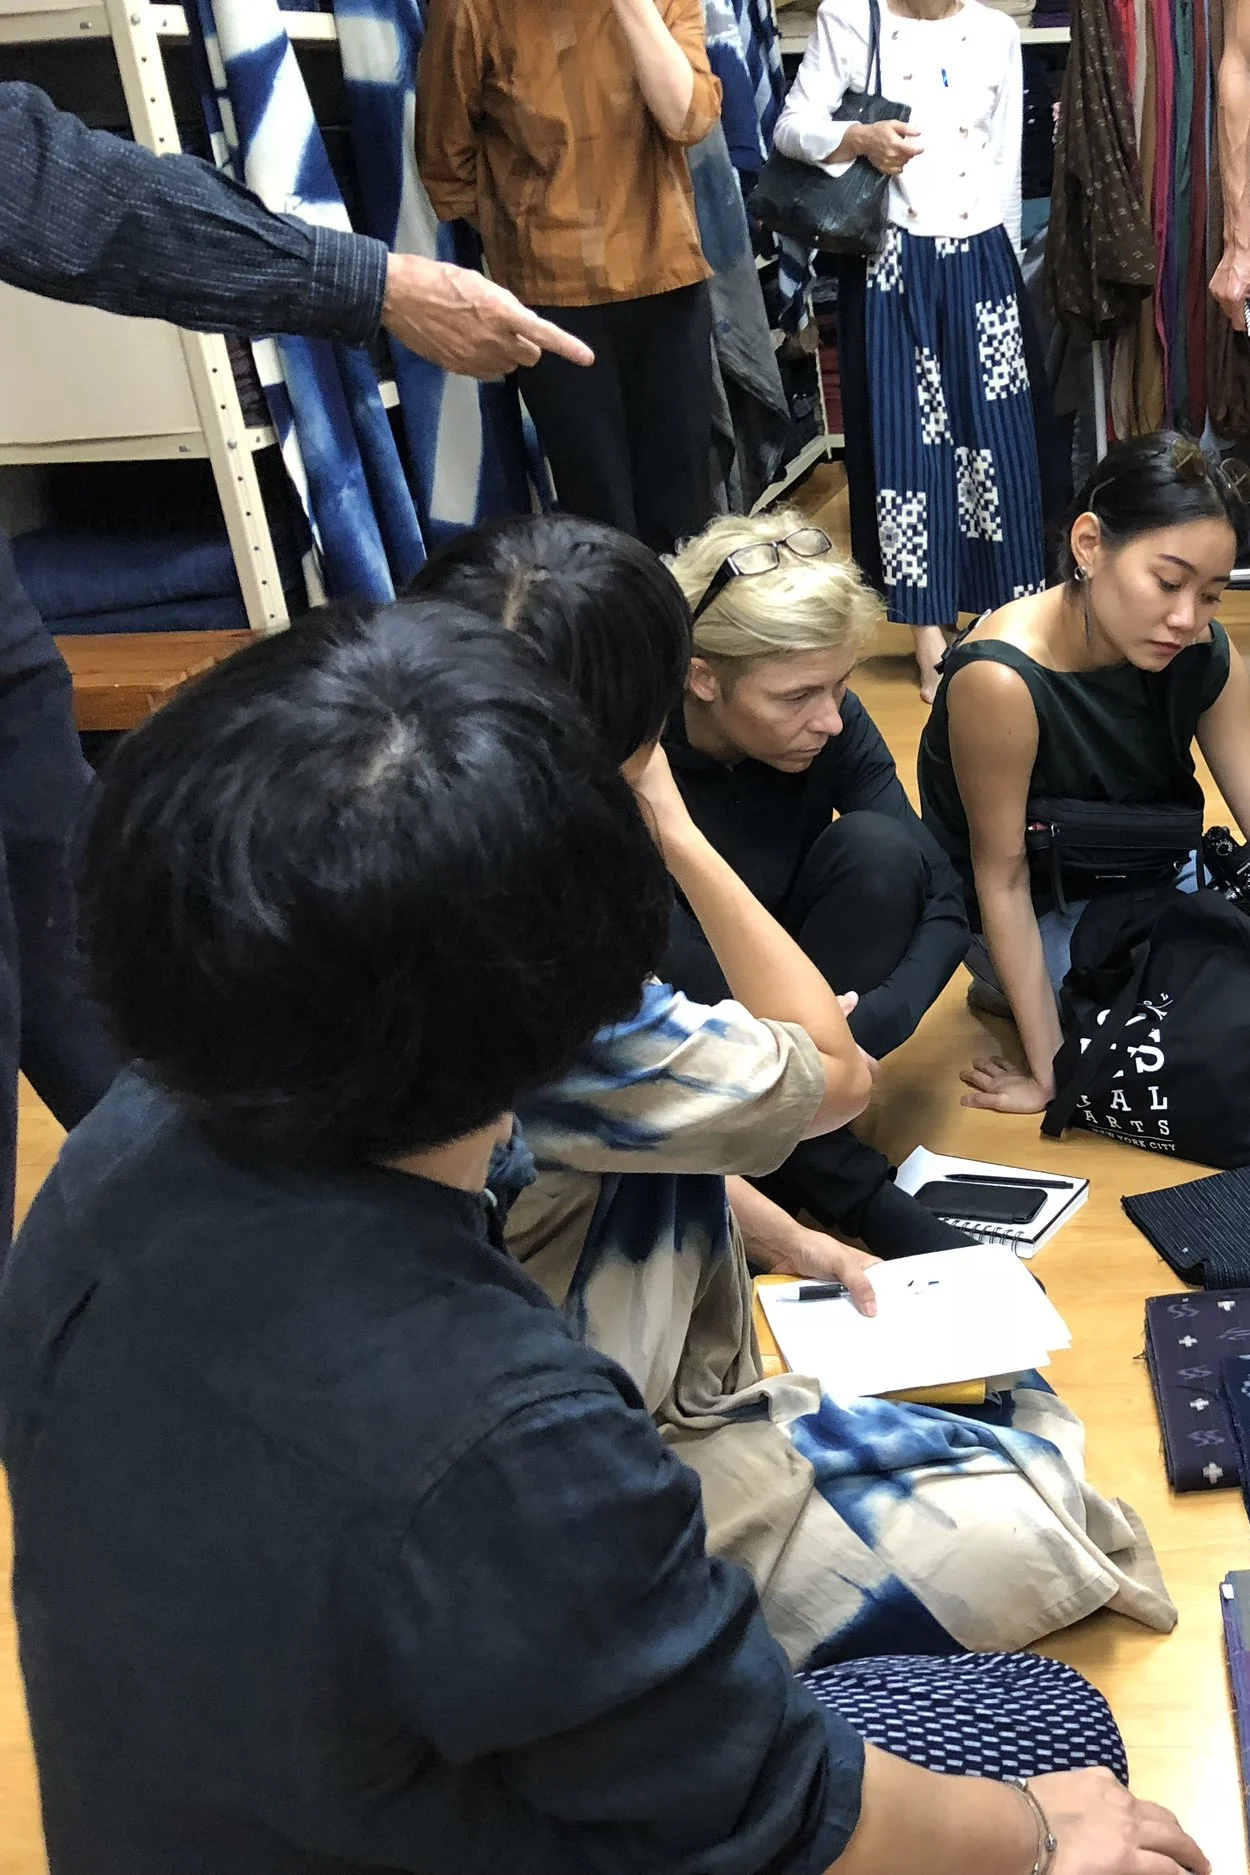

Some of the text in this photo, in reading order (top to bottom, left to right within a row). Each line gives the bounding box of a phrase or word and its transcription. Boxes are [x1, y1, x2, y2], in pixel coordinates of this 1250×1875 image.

[1084, 1110, 1170, 1135] ARTS
[1117, 1134, 1147, 1148] YORK
[1149, 1141, 1176, 1151] CITY
